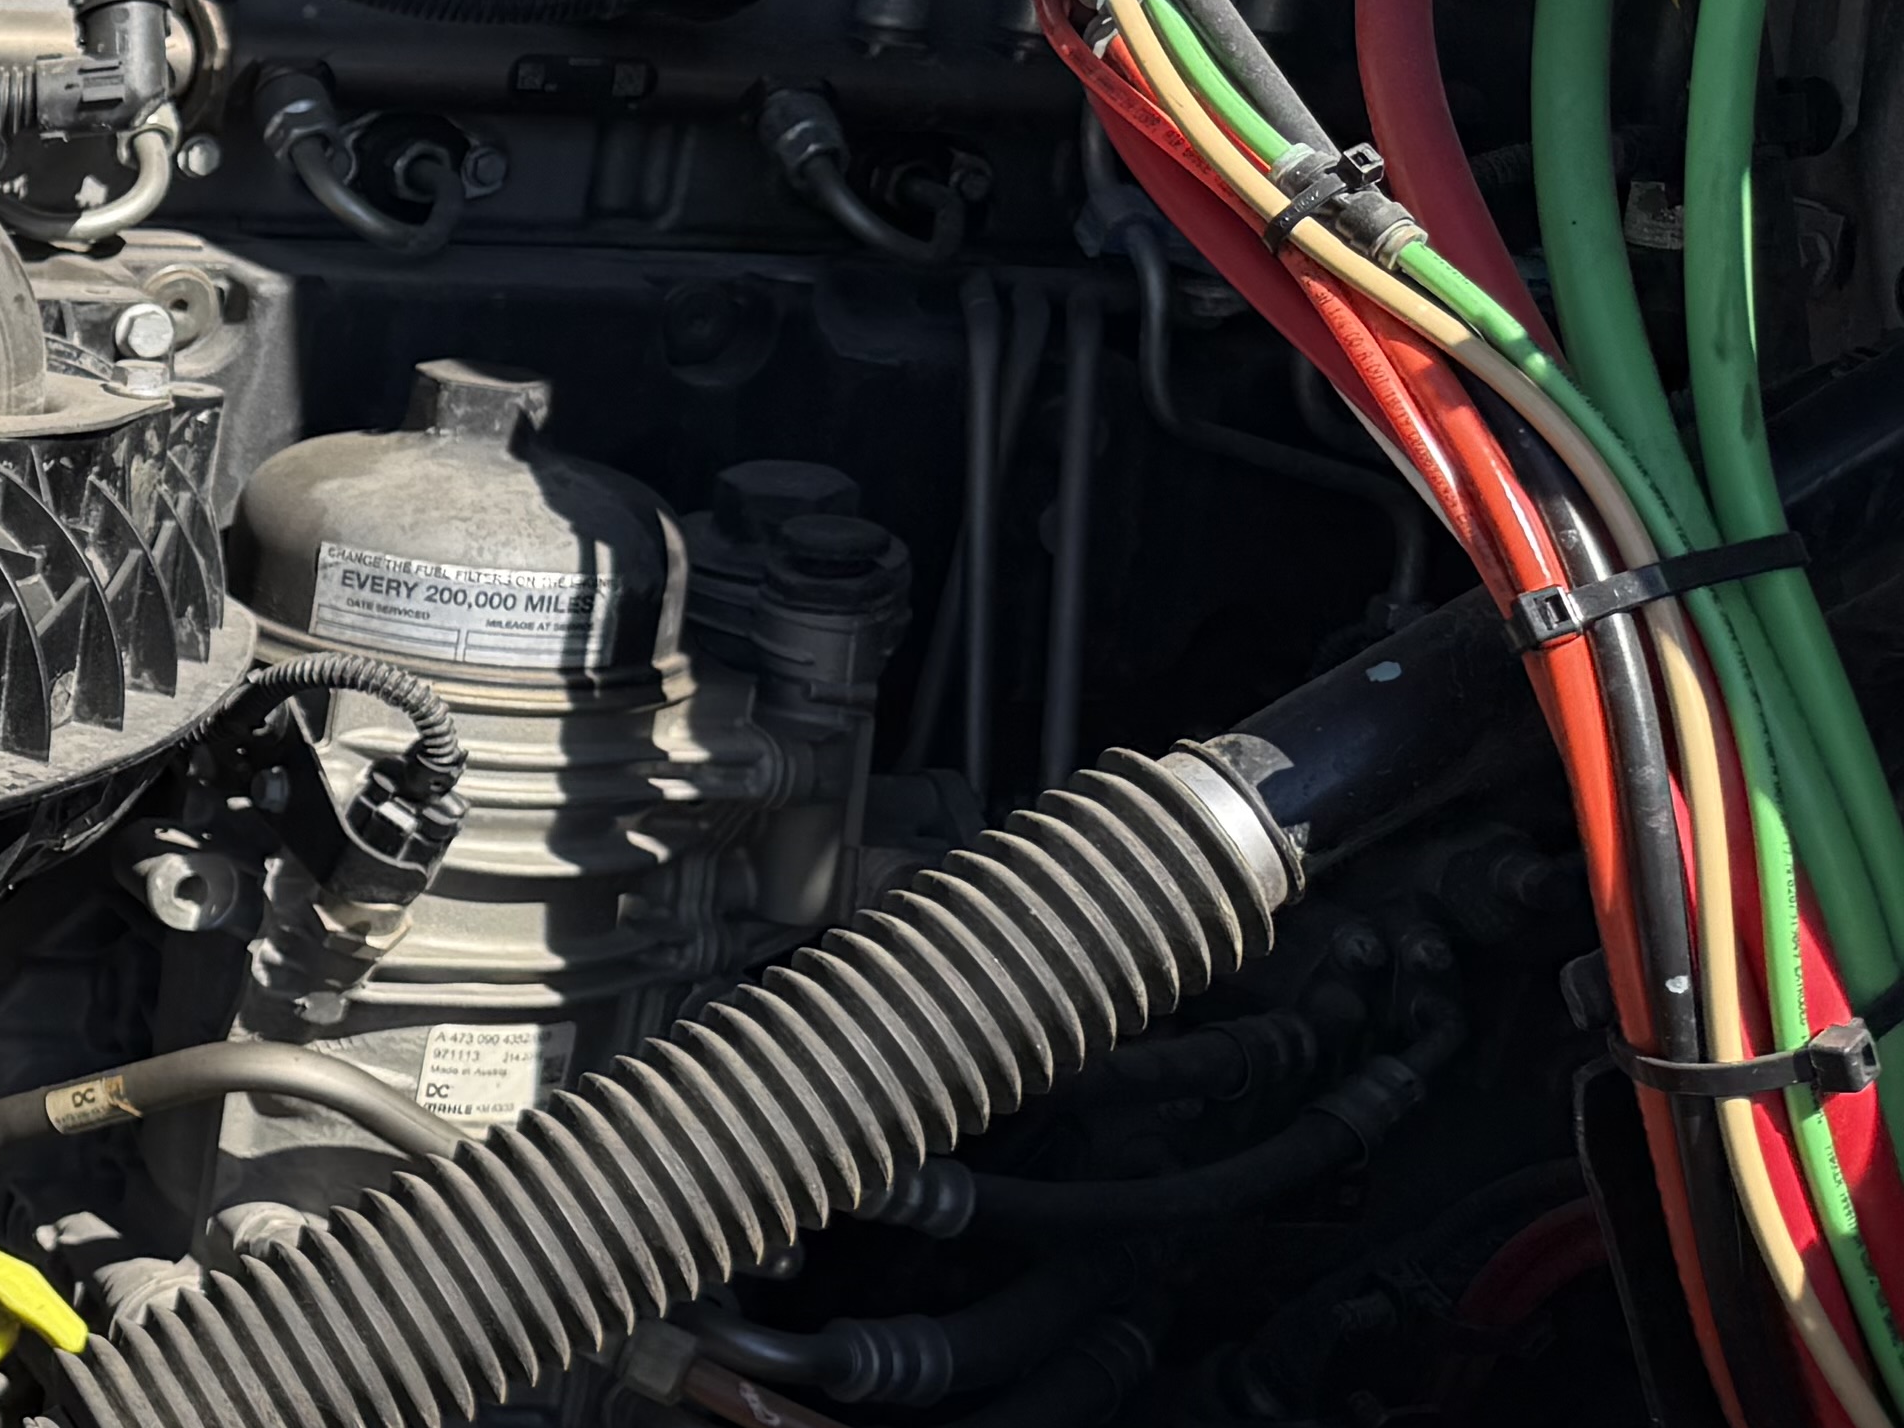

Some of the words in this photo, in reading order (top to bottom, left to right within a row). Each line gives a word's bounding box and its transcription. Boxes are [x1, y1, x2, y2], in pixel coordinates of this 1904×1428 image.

[328, 547, 381, 569] CHANGE
[384, 554, 412, 574] THE
[415, 564, 451, 580] FUEL
[341, 569, 420, 600] EVERY
[424, 585, 518, 612] 200,000
[524, 593, 595, 614] MILES
[346, 597, 373, 611] DATE
[376, 602, 431, 620] SERVICED
[485, 618, 535, 631] MILEAGE
[537, 621, 551, 631] AT
[71, 1088, 96, 1109] DC
[425, 1082, 450, 1099] DC
